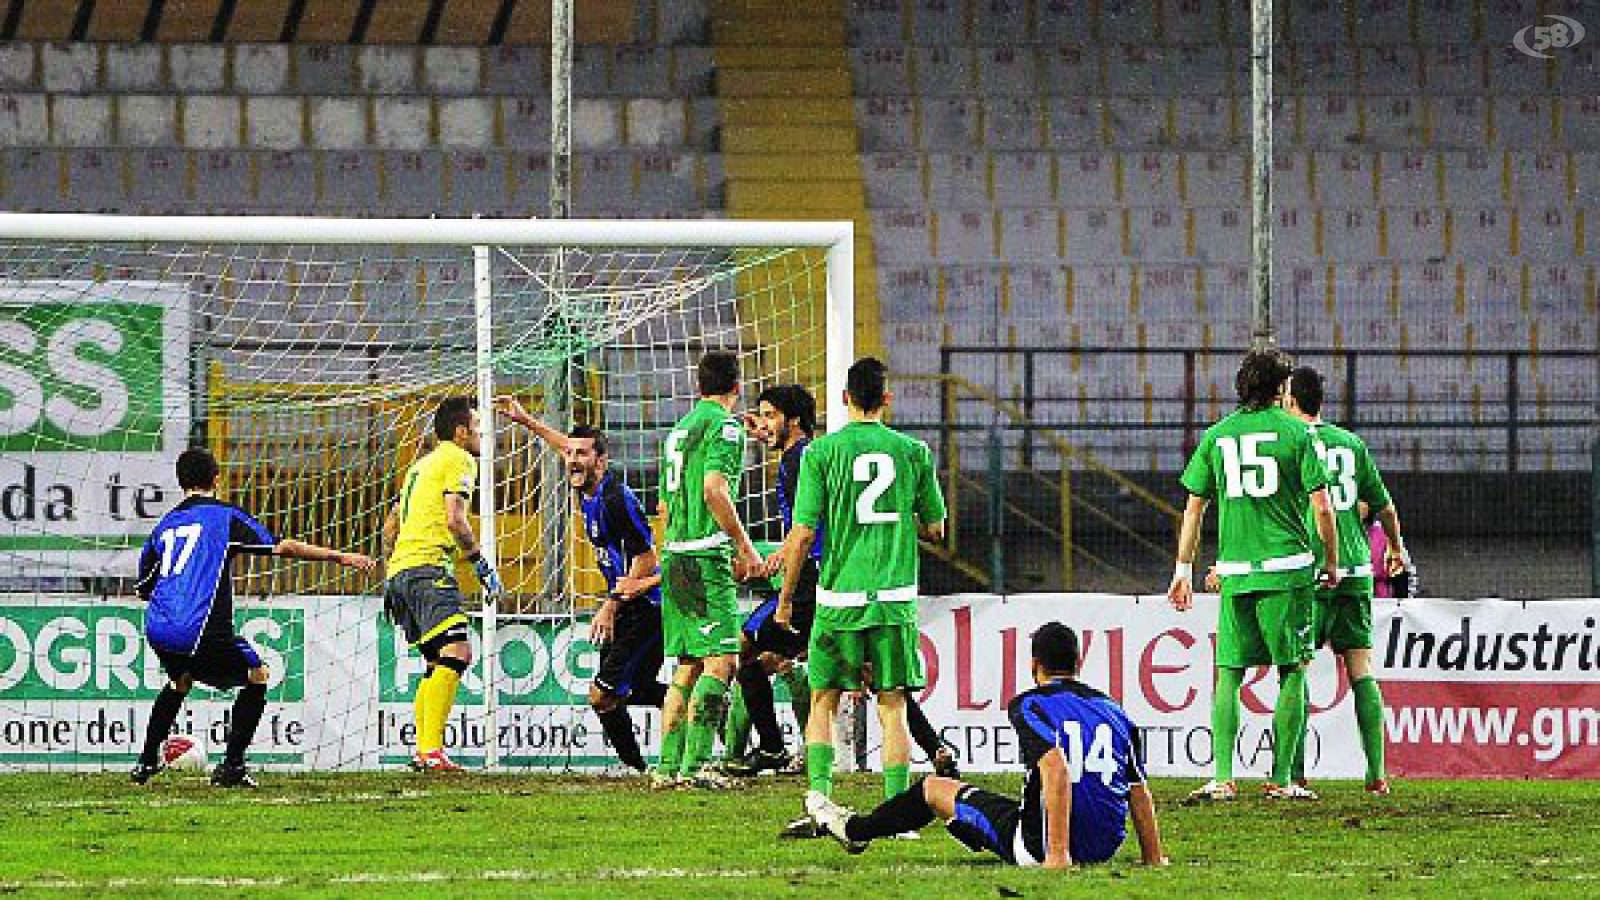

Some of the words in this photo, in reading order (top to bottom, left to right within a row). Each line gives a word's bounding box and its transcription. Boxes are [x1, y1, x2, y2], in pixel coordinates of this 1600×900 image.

[666, 430, 689, 492] 5
[853, 453, 901, 524] 2
[1216, 432, 1278, 497] 15
[1, 465, 75, 522] da
[106, 473, 164, 521] te
[160, 523, 203, 578] 17
[1383, 617, 1600, 671] Industri
[87, 708, 137, 745] del
[271, 713, 305, 746] te
[377, 710, 588, 748] l'eoluzione
[1063, 720, 1119, 786] 14
